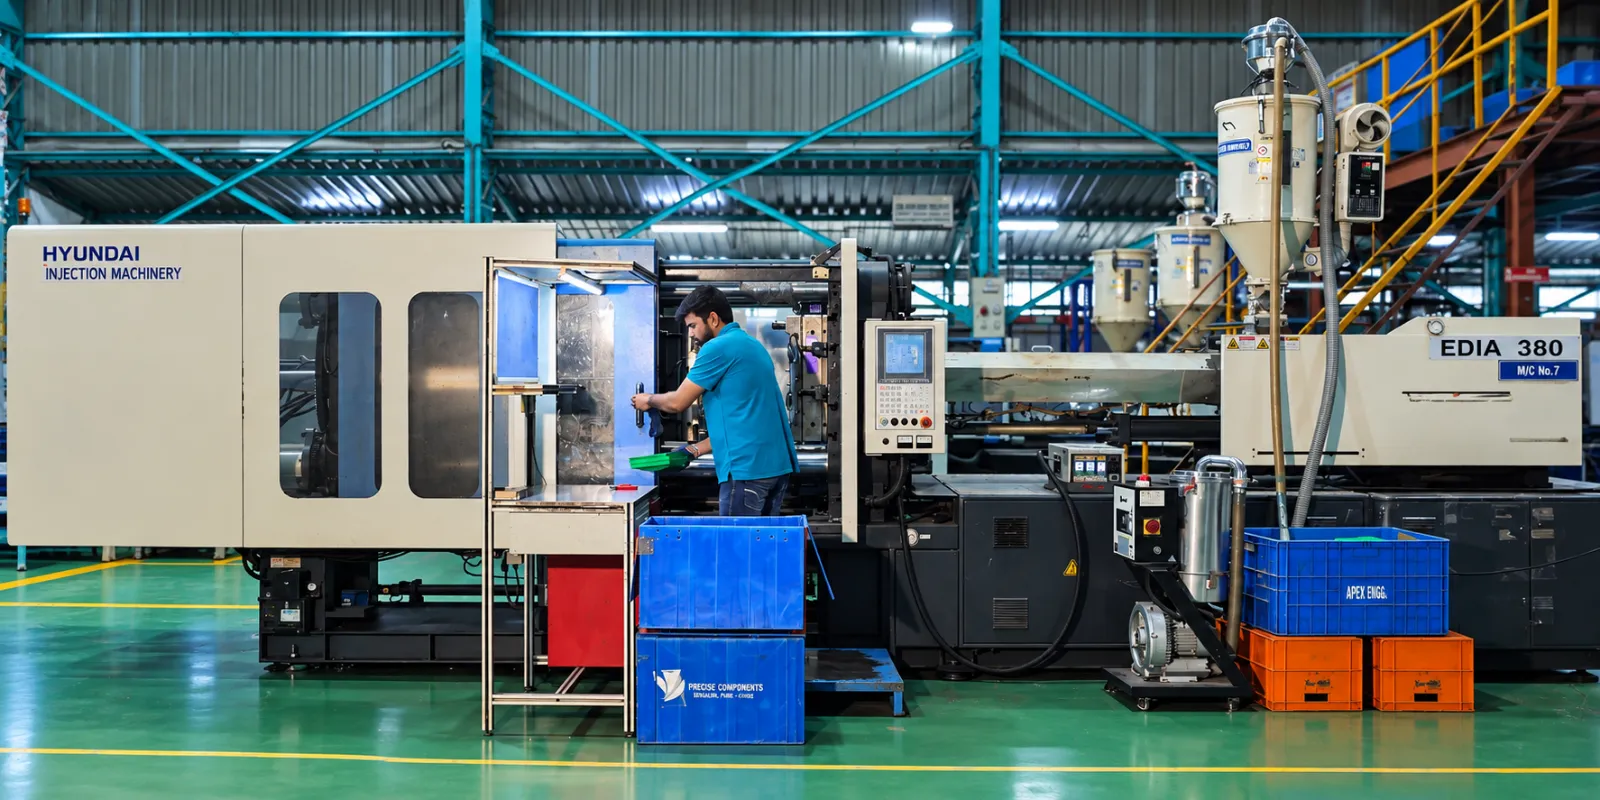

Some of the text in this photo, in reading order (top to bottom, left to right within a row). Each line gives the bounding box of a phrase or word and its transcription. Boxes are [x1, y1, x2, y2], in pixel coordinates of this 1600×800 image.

[42, 245, 140, 262] HYUNDAI
[45, 267, 182, 281] INJECTION MACHINERY
[1440, 339, 1563, 357] EDIA 380
[1517, 365, 1560, 376] M/C No.7
[1346, 585, 1366, 600] APEX
[688, 683, 764, 691] PRECISE COMPONENTS
